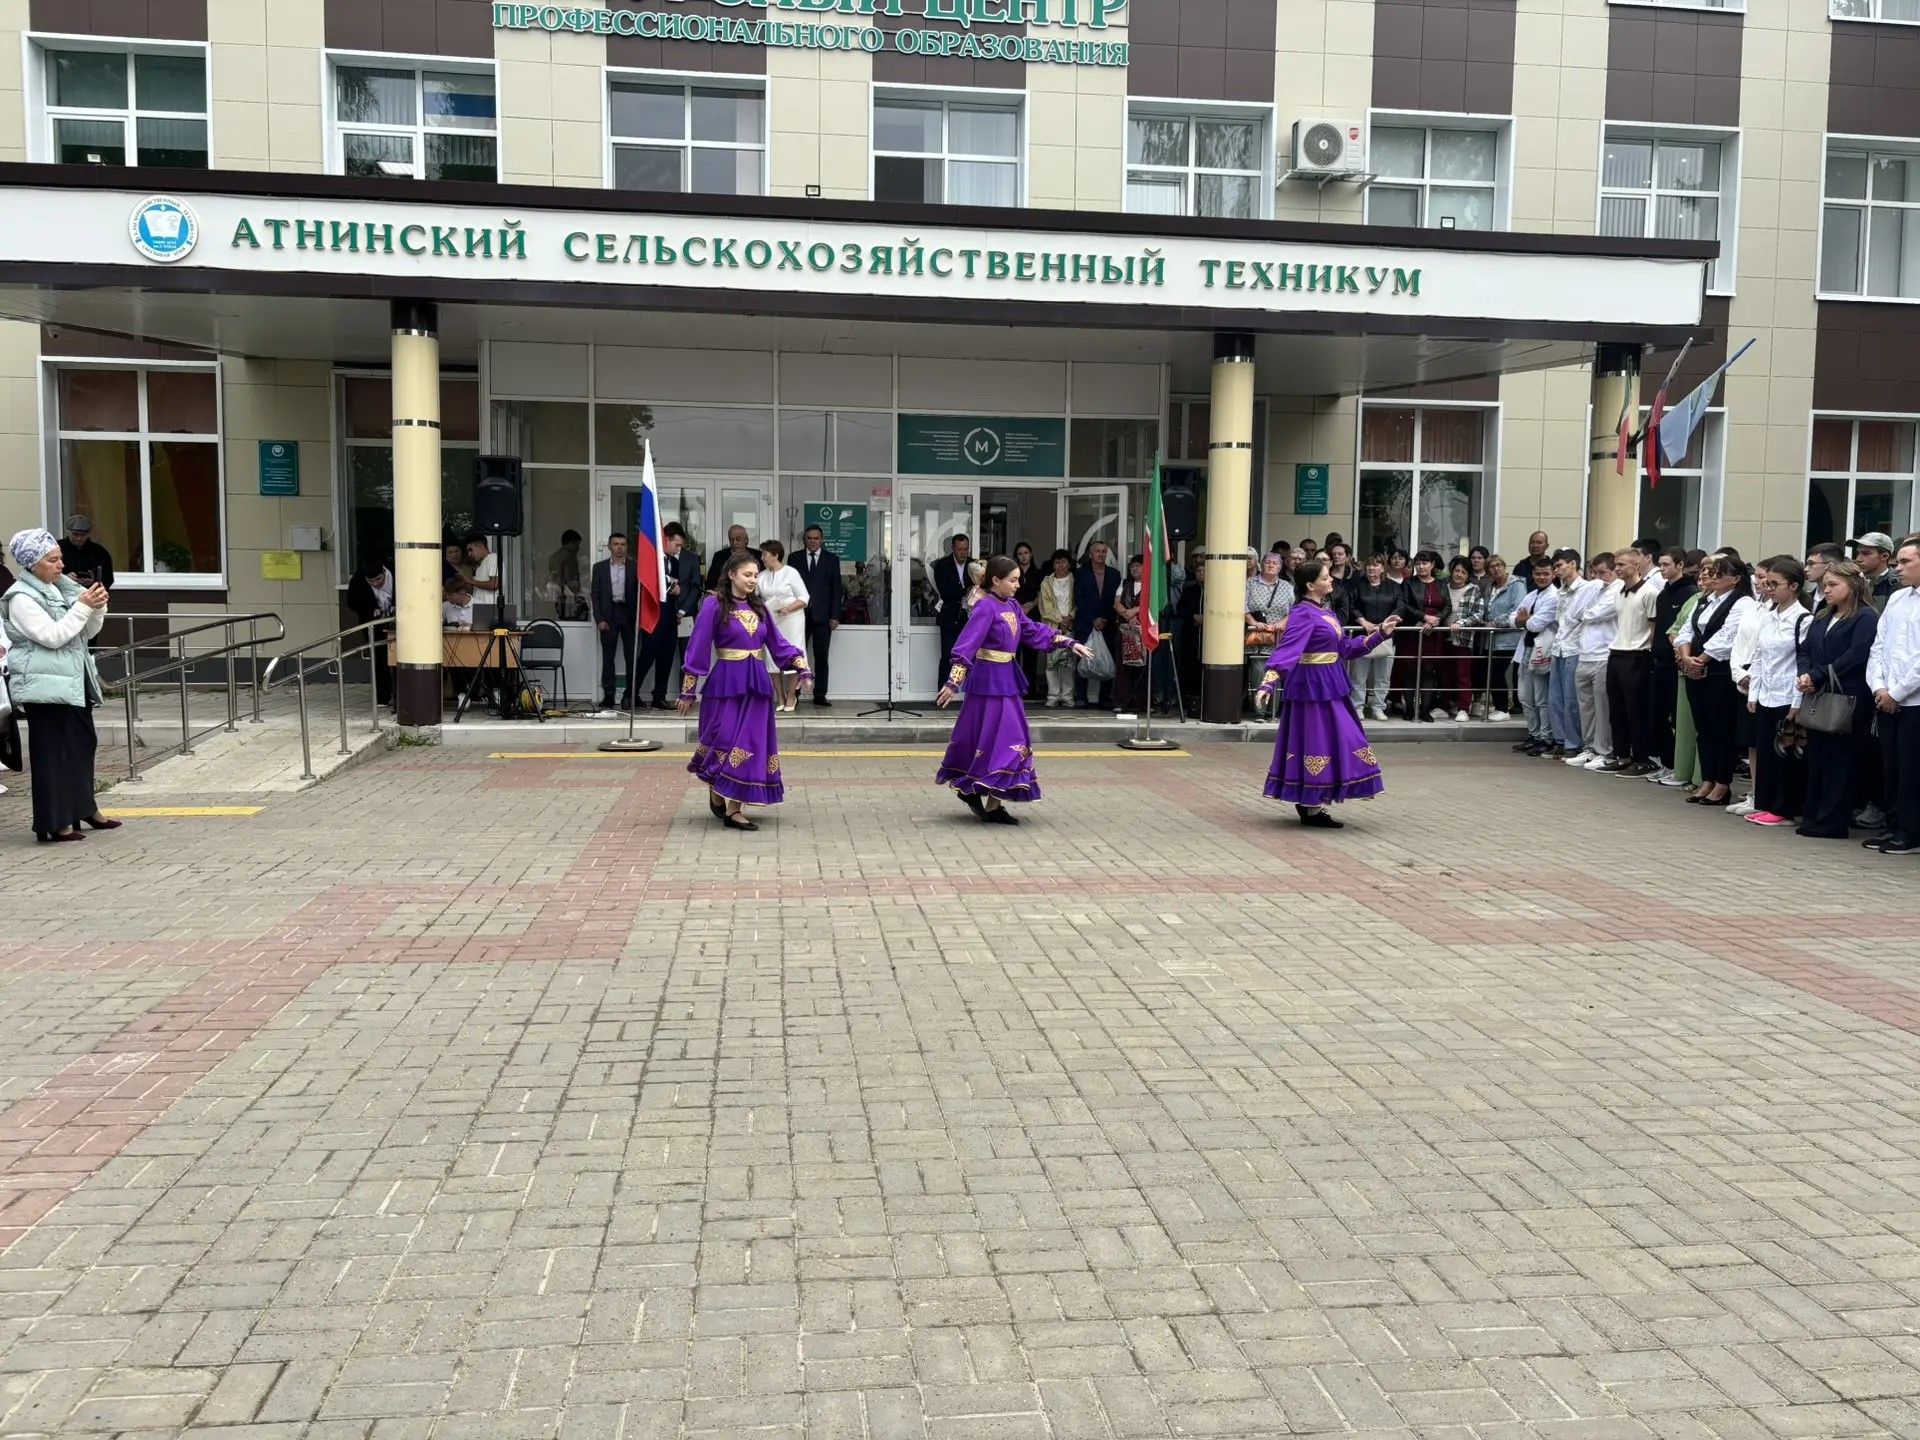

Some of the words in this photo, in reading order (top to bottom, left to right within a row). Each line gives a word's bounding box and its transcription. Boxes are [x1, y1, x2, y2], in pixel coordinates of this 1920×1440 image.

[493, 3, 884, 52] ПРОФЕССИОНАЛЬНОГО
[895, 29, 1129, 65] ОБРАЗОВАНИЯ
[231, 217, 527, 260] АТНИНСКИЙ
[564, 231, 1166, 285] СЕЛЬСКОХОЗЯЙСТВЕННЫЙ
[1200, 259, 1423, 297] ТЕХНИКУМ
